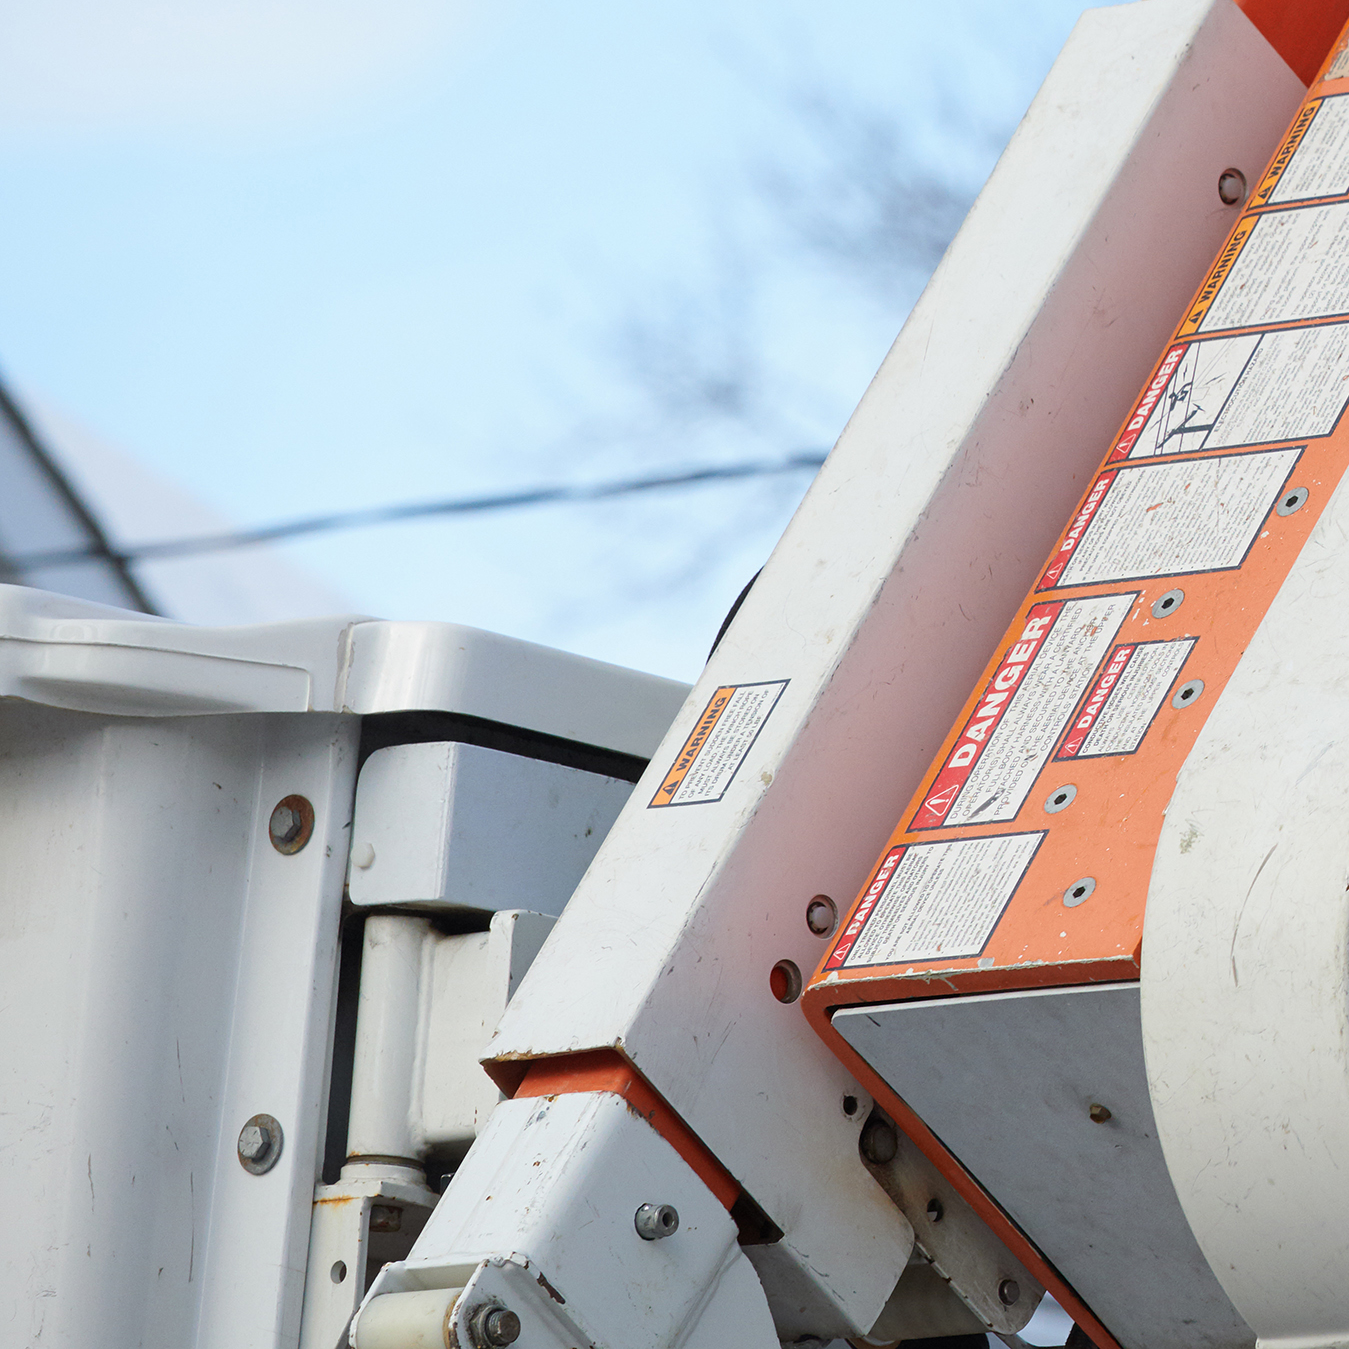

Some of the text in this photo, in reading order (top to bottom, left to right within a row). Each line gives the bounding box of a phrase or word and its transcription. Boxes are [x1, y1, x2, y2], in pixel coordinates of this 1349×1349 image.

[1267, 106, 1316, 179] WARNING
[1197, 230, 1247, 303] WARNING
[1127, 349, 1183, 430] DANGER
[1060, 478, 1109, 551] DANGER
[947, 615, 1051, 767] DANGER
[949, 604, 1075, 819] DURING OPERATION OF THIS AERIAL DEVICE, THE
[961, 756, 1001, 816] OPERATOR(S)
[995, 728, 1016, 754] SHALL
[1012, 690, 1037, 724] ALWAYS
[1032, 662, 1052, 688] WEAR
[1052, 607, 1083, 653] CERTIFIED
[984, 773, 1002, 792] FULL
[997, 745, 1016, 769] BODY
[1012, 700, 1041, 742] HARNESS
[1037, 676, 1055, 699] WITH
[1054, 626, 1083, 667] LANYARD
[993, 603, 1116, 815] PROVIDED ON THE AERIAL DEVICE AT THE UPPER
[1017, 735, 1033, 753] AND
[1028, 690, 1057, 733] SECURED
[1052, 676, 1065, 688] TO
[1060, 657, 1076, 675] THE
[1076, 648, 1130, 728] DANGER
[675, 696, 727, 771] WARNING
[845, 854, 899, 935] DANGER
